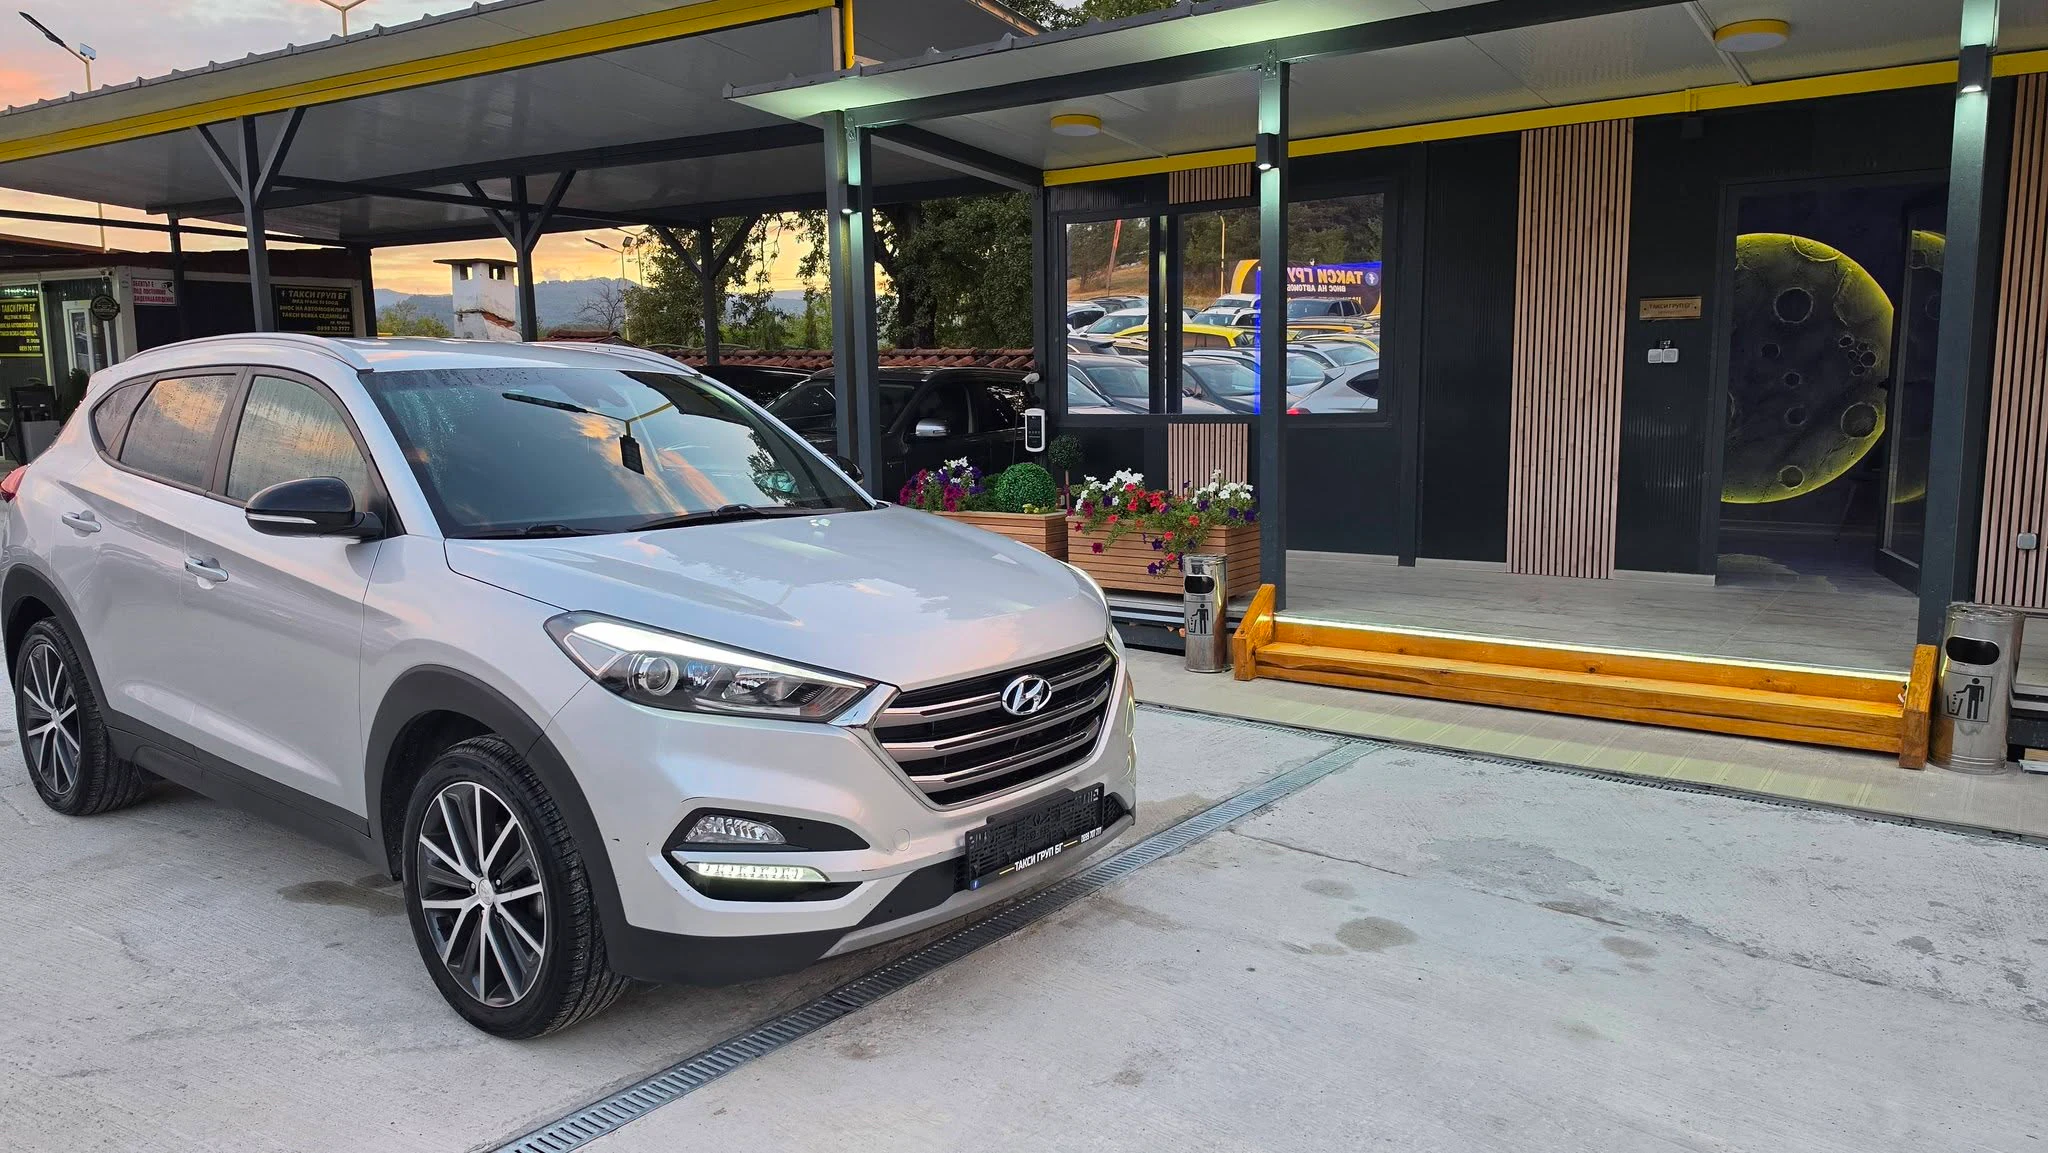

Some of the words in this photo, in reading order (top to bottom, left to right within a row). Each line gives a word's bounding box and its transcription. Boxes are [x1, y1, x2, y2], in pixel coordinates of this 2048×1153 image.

[289, 290, 316, 298] ТАКСИ
[316, 291, 337, 300] ГРУП
[1015, 854, 1035, 871] ТАКСИ
[1036, 846, 1054, 862] ГРУП
[1054, 842, 1064, 855] БГ
